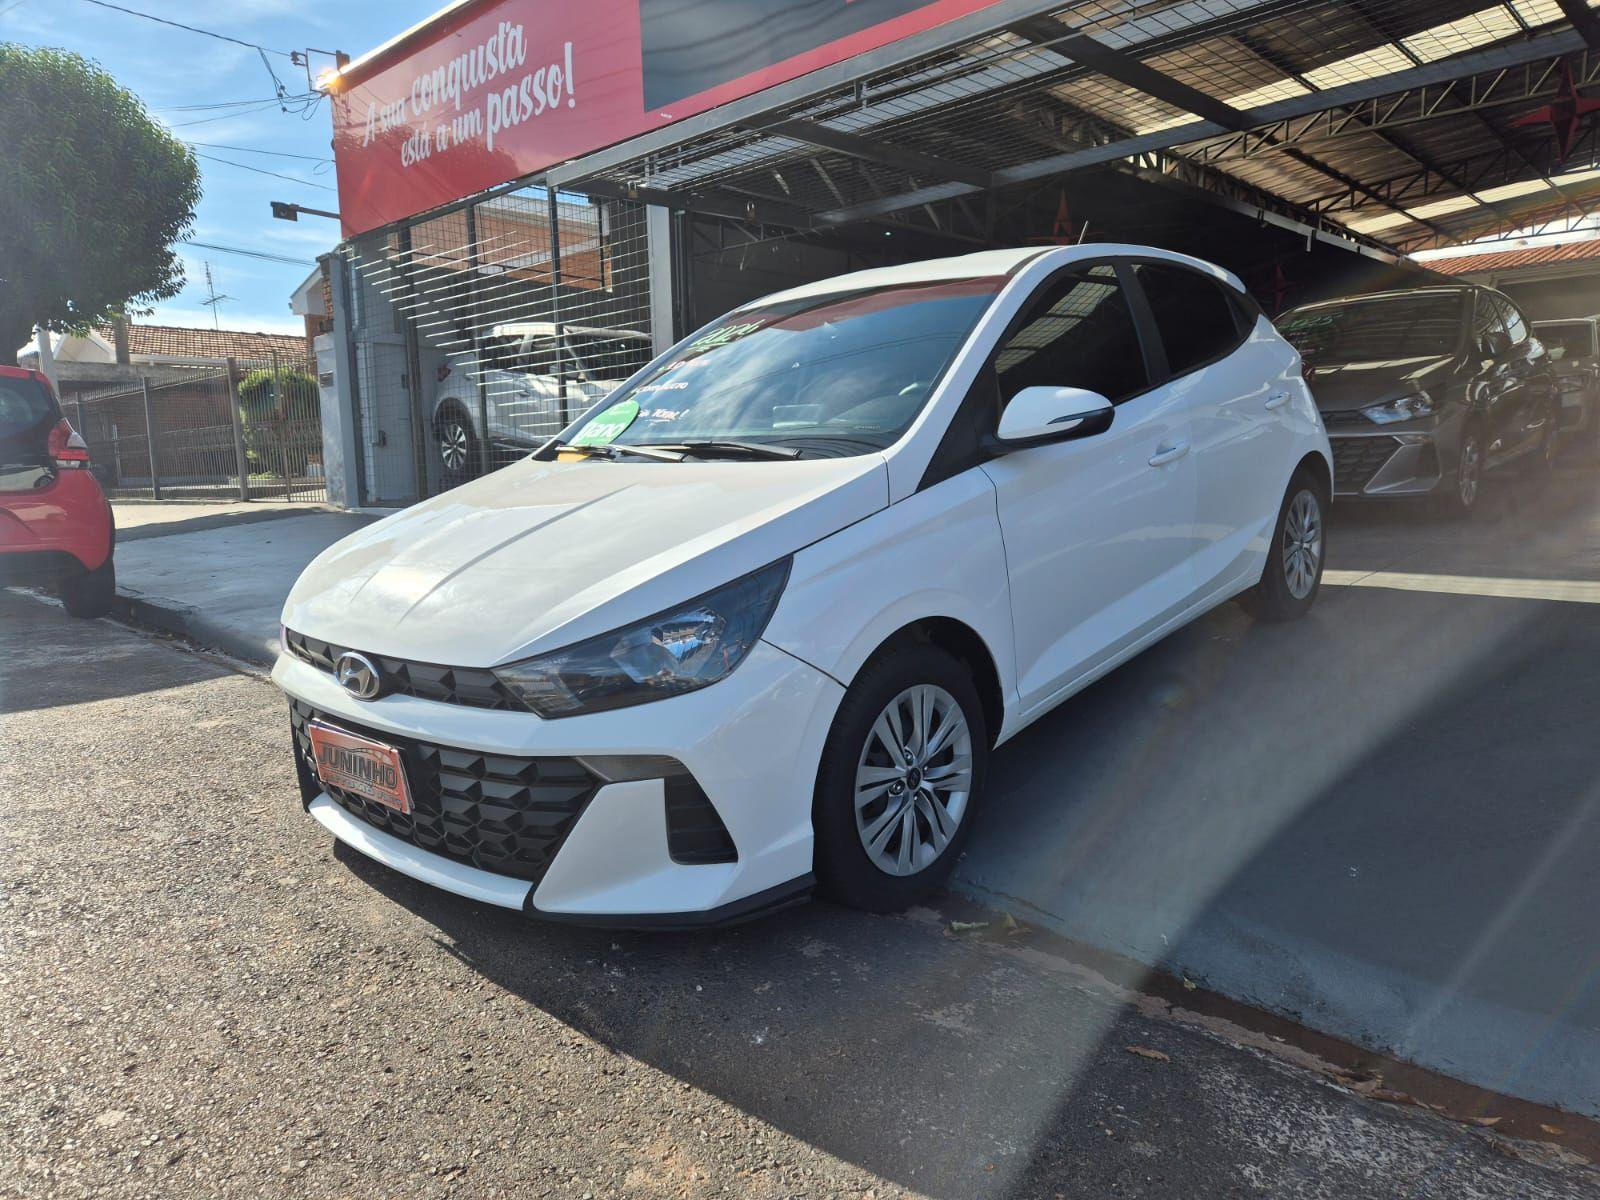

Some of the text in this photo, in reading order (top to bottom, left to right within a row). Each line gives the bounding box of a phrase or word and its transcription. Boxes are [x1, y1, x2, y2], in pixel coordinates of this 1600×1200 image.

[362, 101, 376, 147] A
[381, 97, 407, 132] sua
[401, 42, 576, 167] está a um passo!
[319, 745, 396, 787] JUNINHO
